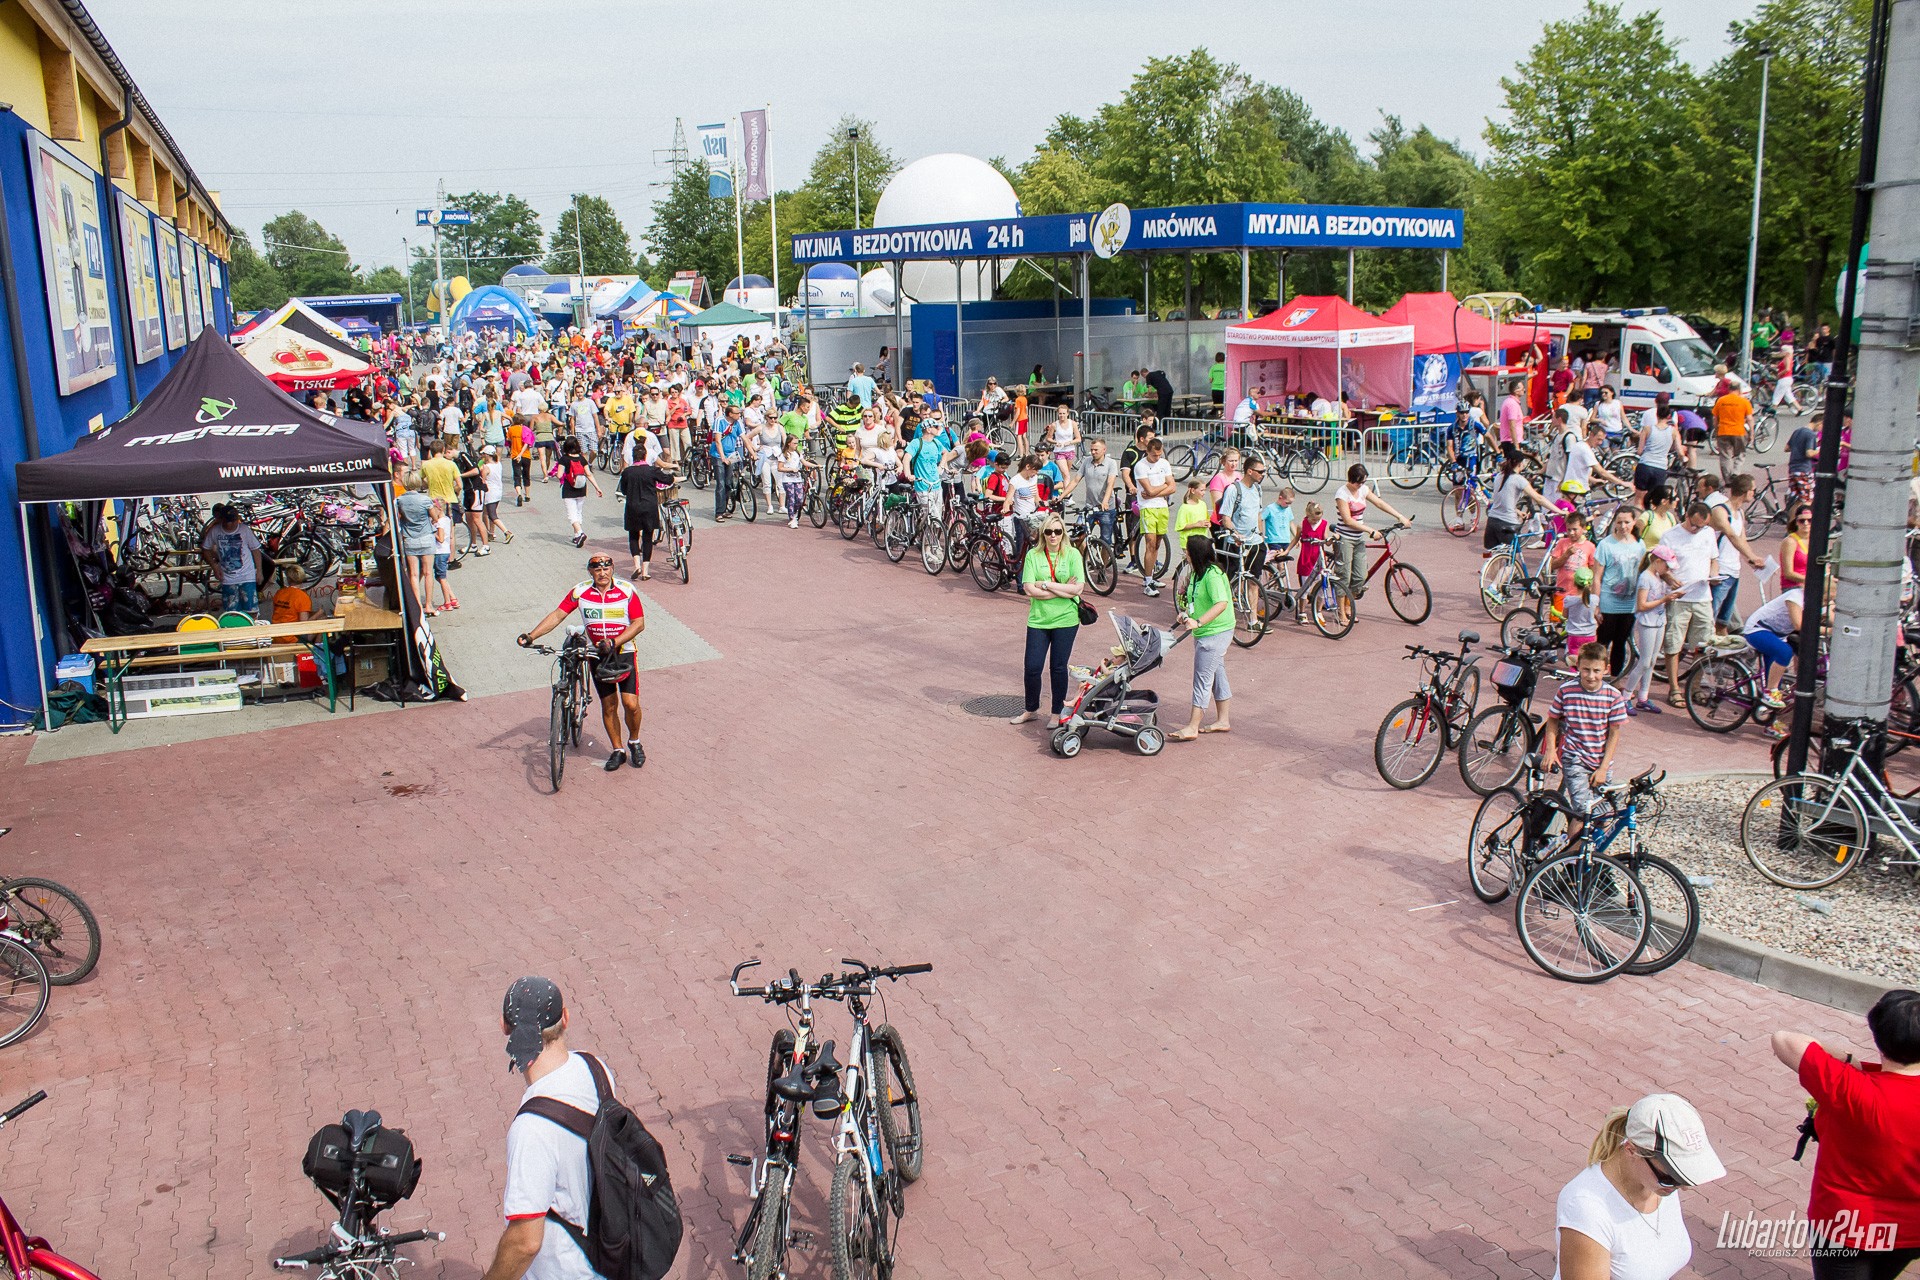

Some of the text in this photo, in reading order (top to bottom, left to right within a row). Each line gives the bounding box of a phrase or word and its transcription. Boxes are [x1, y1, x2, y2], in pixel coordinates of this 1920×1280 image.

[751, 117, 760, 176] WIŚNIOWSKI
[1069, 212, 1218, 248] psb MRÓWKA
[1248, 213, 1456, 239] MYJNIA BEZDOTYKOWA
[794, 236, 843, 259] MYJNIA
[853, 227, 973, 256] BEZDOTYKOWA
[1227, 331, 1257, 340] STAROSTWO
[1257, 334, 1291, 342] POWIATOWE
[293, 377, 337, 390] TYSKIE
[124, 423, 301, 448] MERIDA
[218, 457, 373, 479] WWW.MERIDA-BIKES.COM
